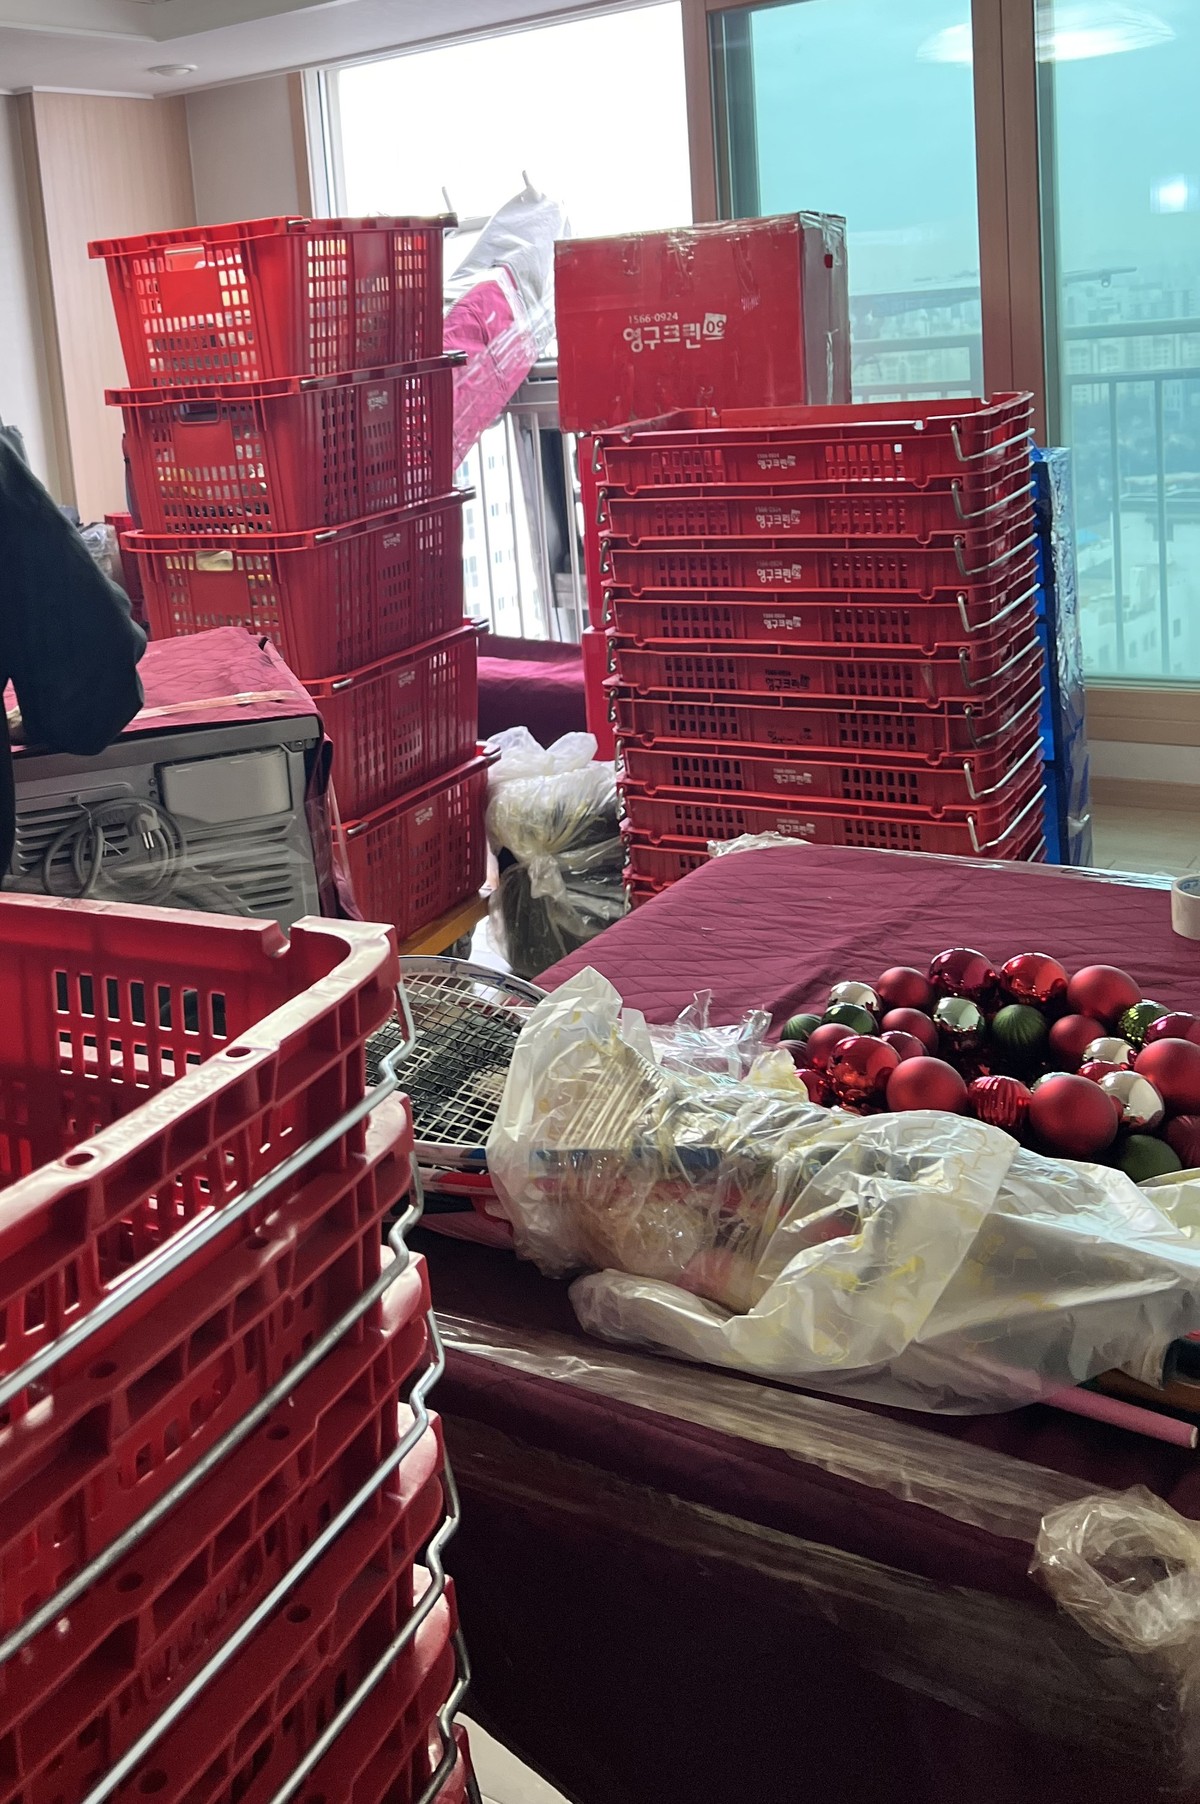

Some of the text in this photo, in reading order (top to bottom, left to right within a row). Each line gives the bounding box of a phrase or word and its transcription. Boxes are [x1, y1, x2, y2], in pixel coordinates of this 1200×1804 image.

[628, 312, 679, 325] 1566-0924
[623, 322, 701, 352] 영구크린
[756, 514, 791, 528] 영구크린
[757, 568, 792, 583] 영구크린
